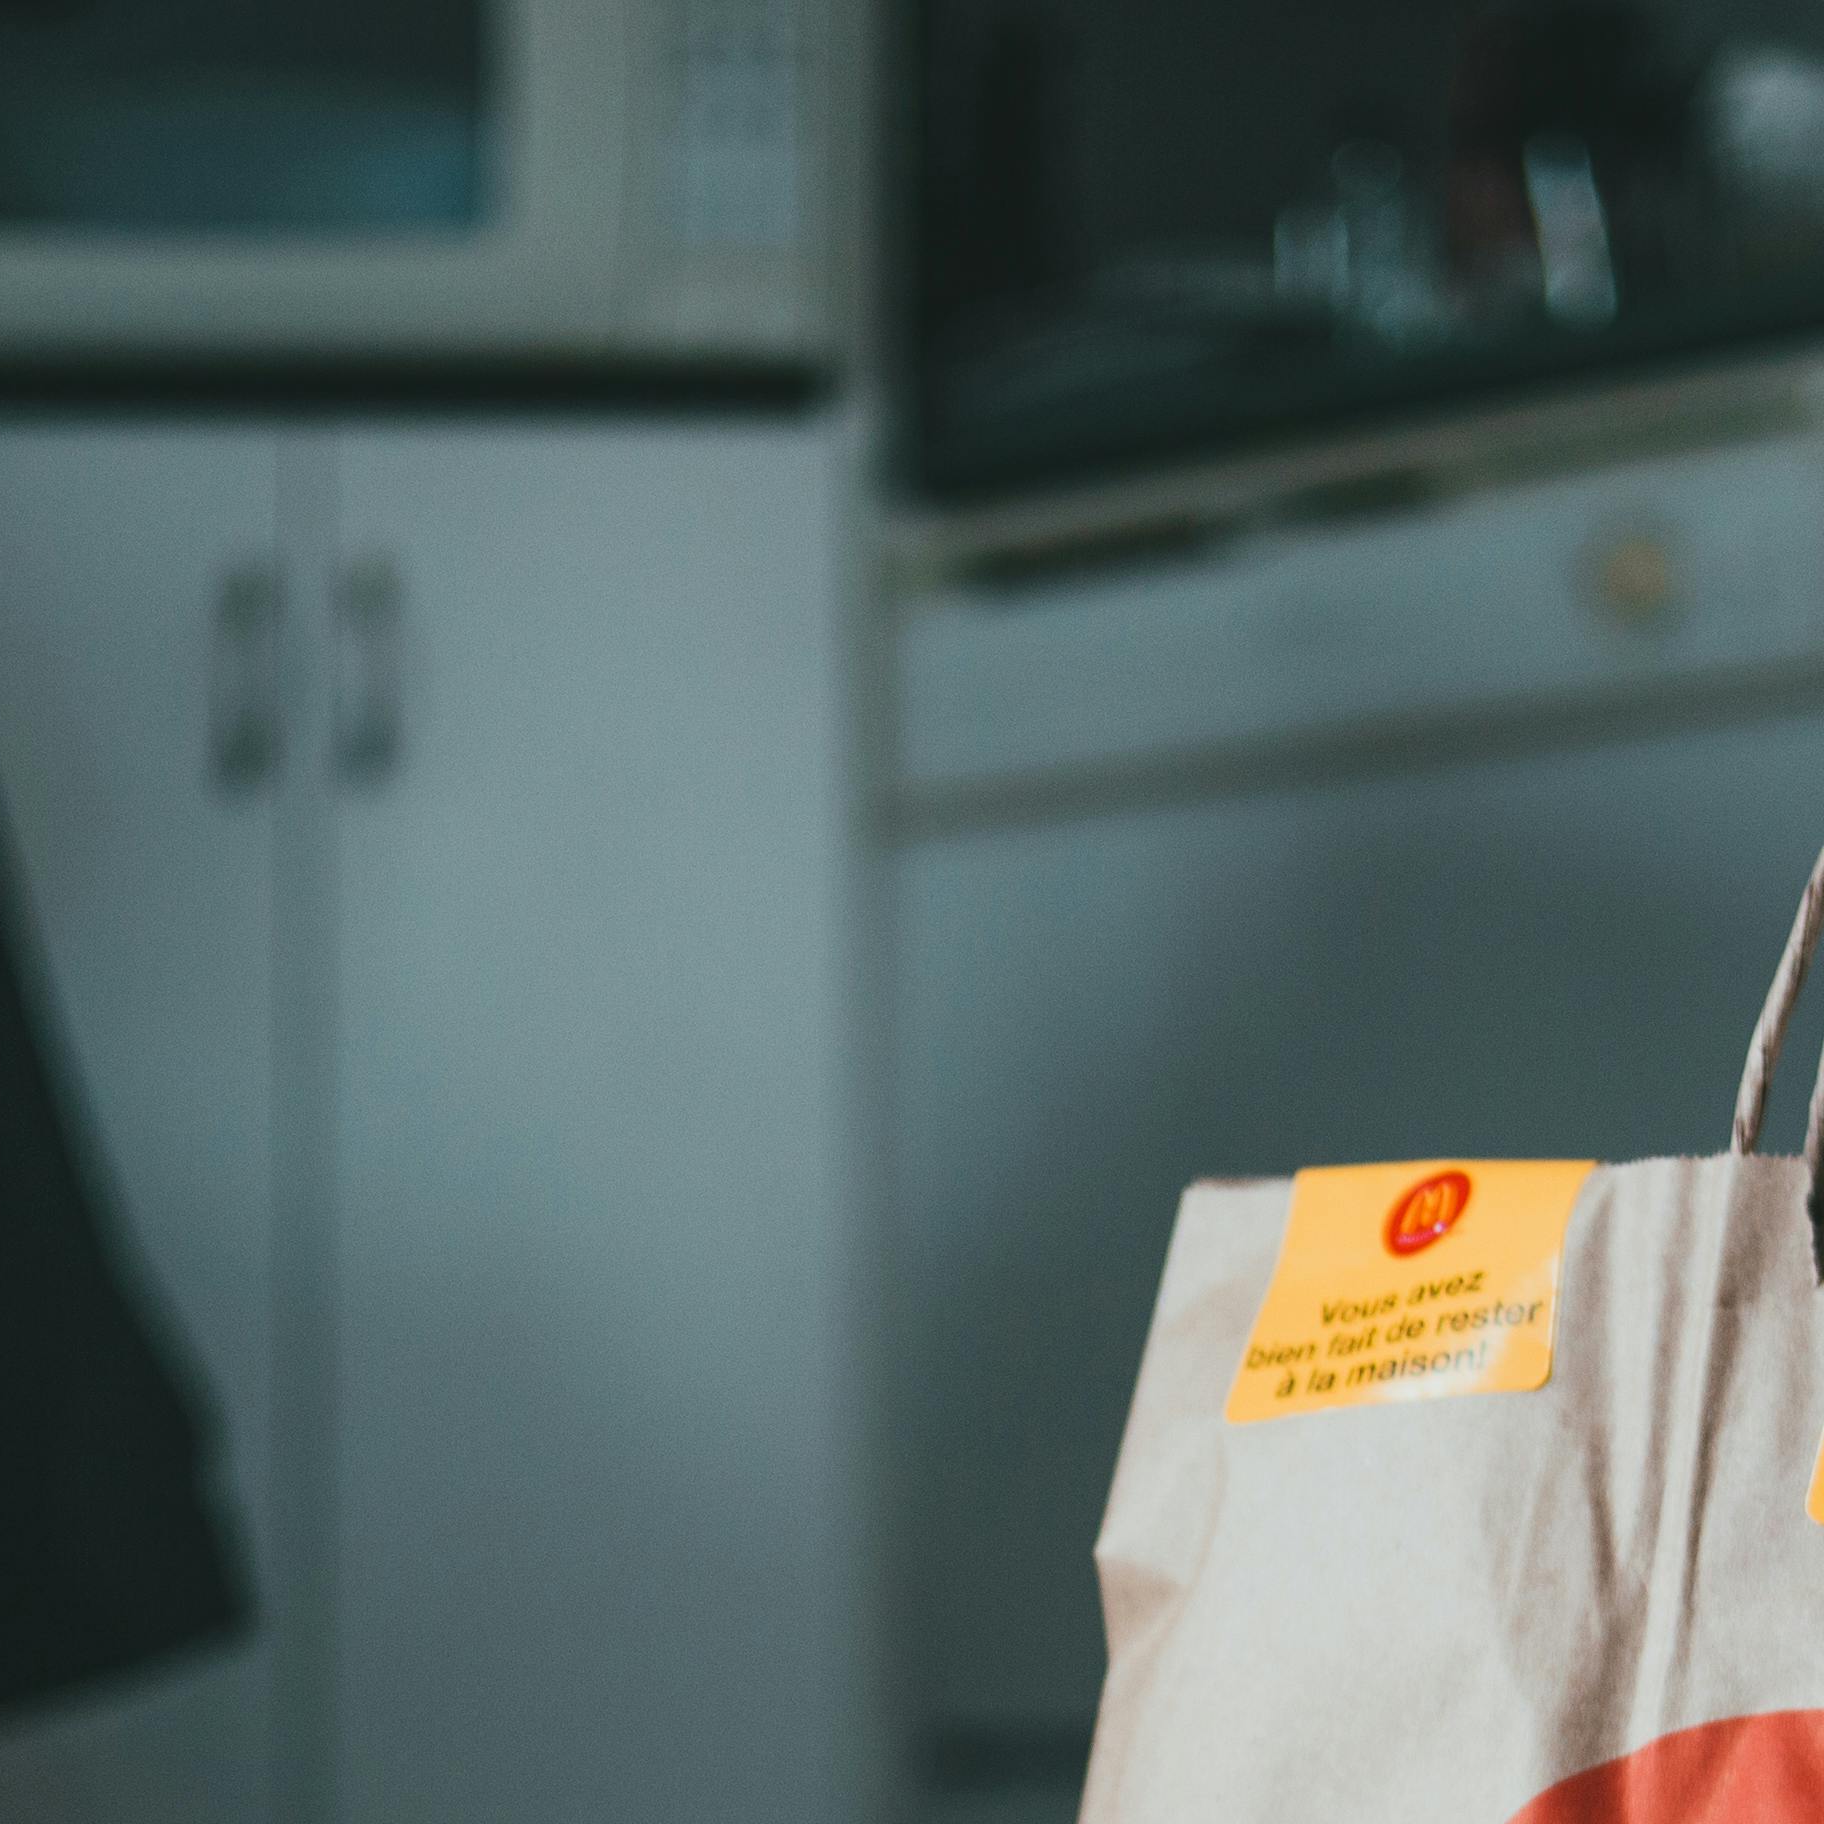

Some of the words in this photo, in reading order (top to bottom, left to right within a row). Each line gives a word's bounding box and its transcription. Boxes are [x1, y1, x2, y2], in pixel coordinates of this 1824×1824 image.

[1321, 1293, 1398, 1328] Vous
[1407, 1270, 1485, 1306] avez
[1246, 1343, 1317, 1372] bien
[1327, 1327, 1377, 1357] fait
[1385, 1314, 1425, 1344] de
[1436, 1300, 1544, 1335] rester
[1275, 1369, 1295, 1399] à
[1306, 1365, 1336, 1395] la
[1345, 1341, 1488, 1389] maison!
